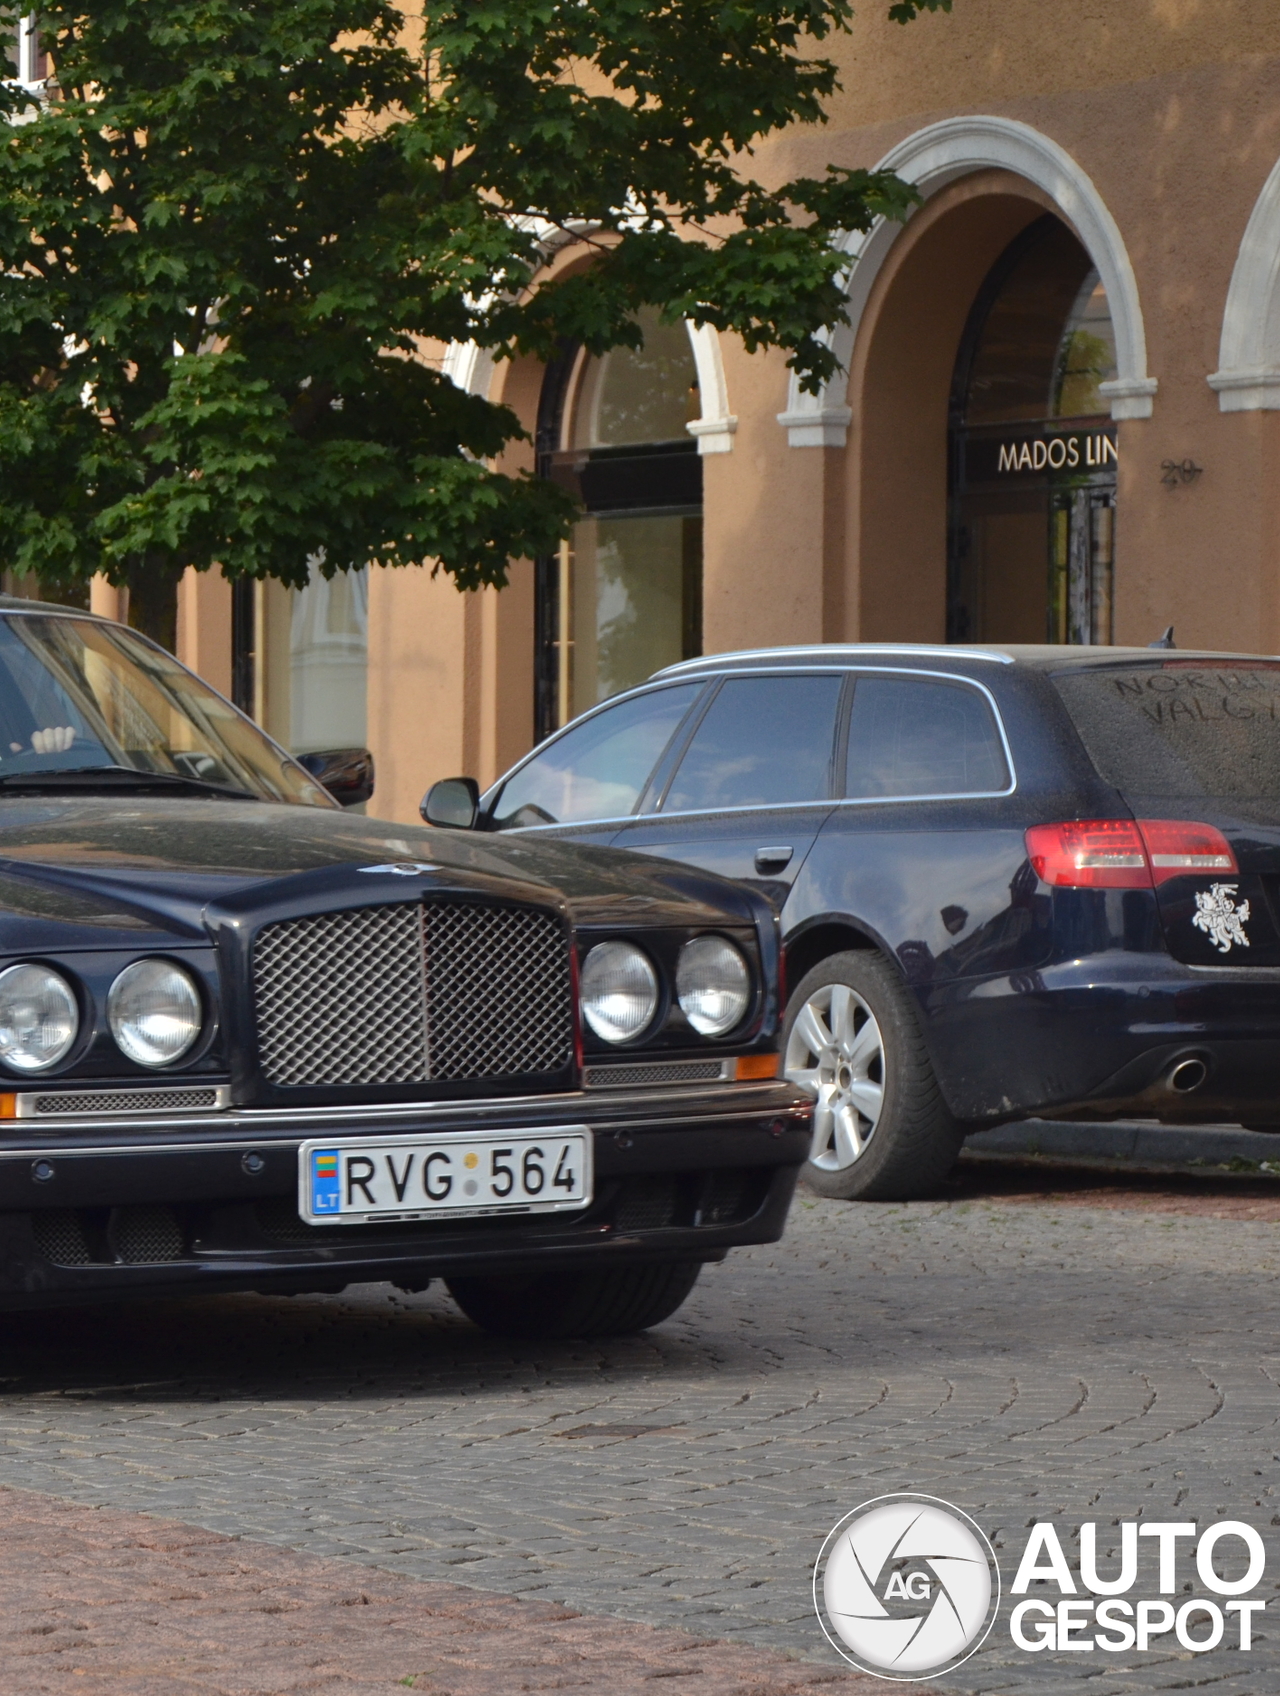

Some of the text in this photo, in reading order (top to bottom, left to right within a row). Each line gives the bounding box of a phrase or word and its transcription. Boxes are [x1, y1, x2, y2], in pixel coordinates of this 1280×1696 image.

[998, 437, 1079, 472] MADOS
[1160, 458, 1197, 483] 20
[344, 1144, 575, 1205] RVG 564
[316, 1193, 339, 1209] LT
